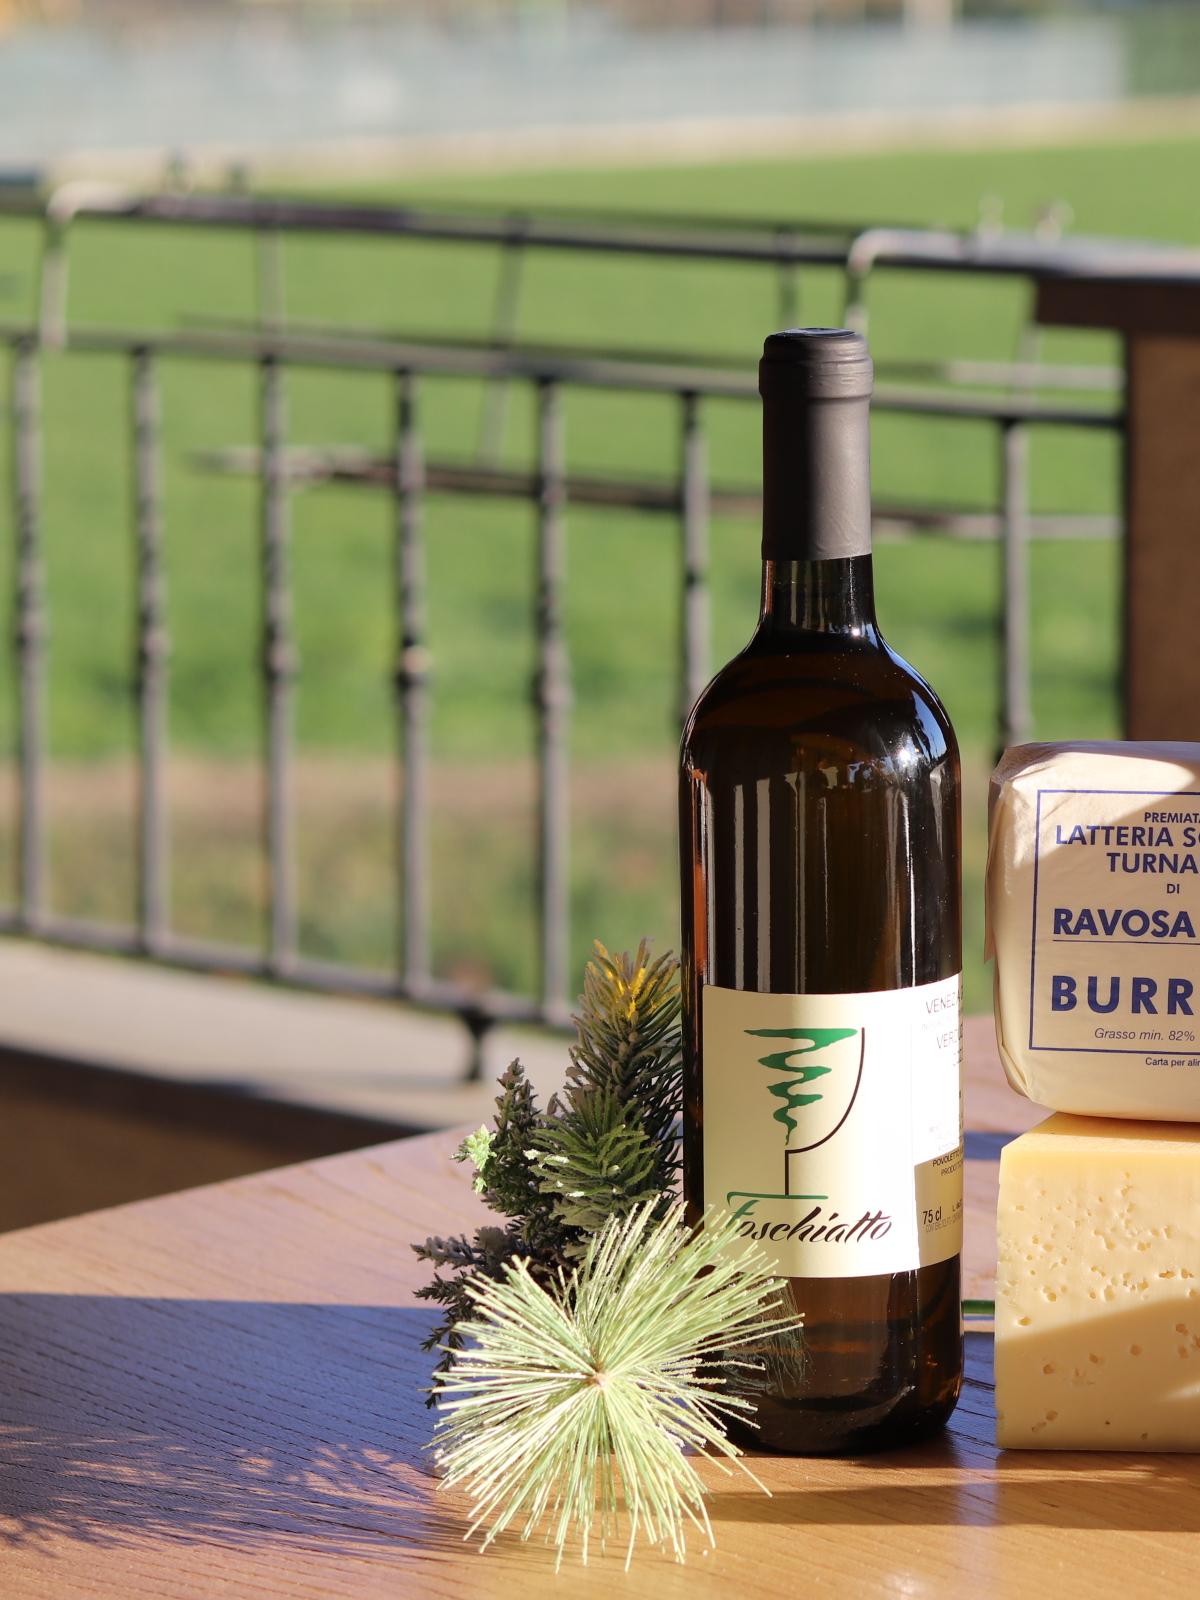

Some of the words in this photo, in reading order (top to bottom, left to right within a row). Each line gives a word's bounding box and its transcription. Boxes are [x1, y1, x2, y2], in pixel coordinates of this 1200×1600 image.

[1055, 825, 1174, 847] LATTERIA
[1166, 883, 1180, 894] DI
[1053, 908, 1196, 938] RAVOSA
[1094, 1028, 1136, 1040] Grasso
[1139, 1029, 1164, 1041] min.
[1168, 1030, 1196, 1042] 82%
[1145, 1057, 1169, 1067] Carta
[1171, 1059, 1185, 1068] per
[922, 1208, 933, 1224] 75
[935, 1205, 942, 1221] cl
